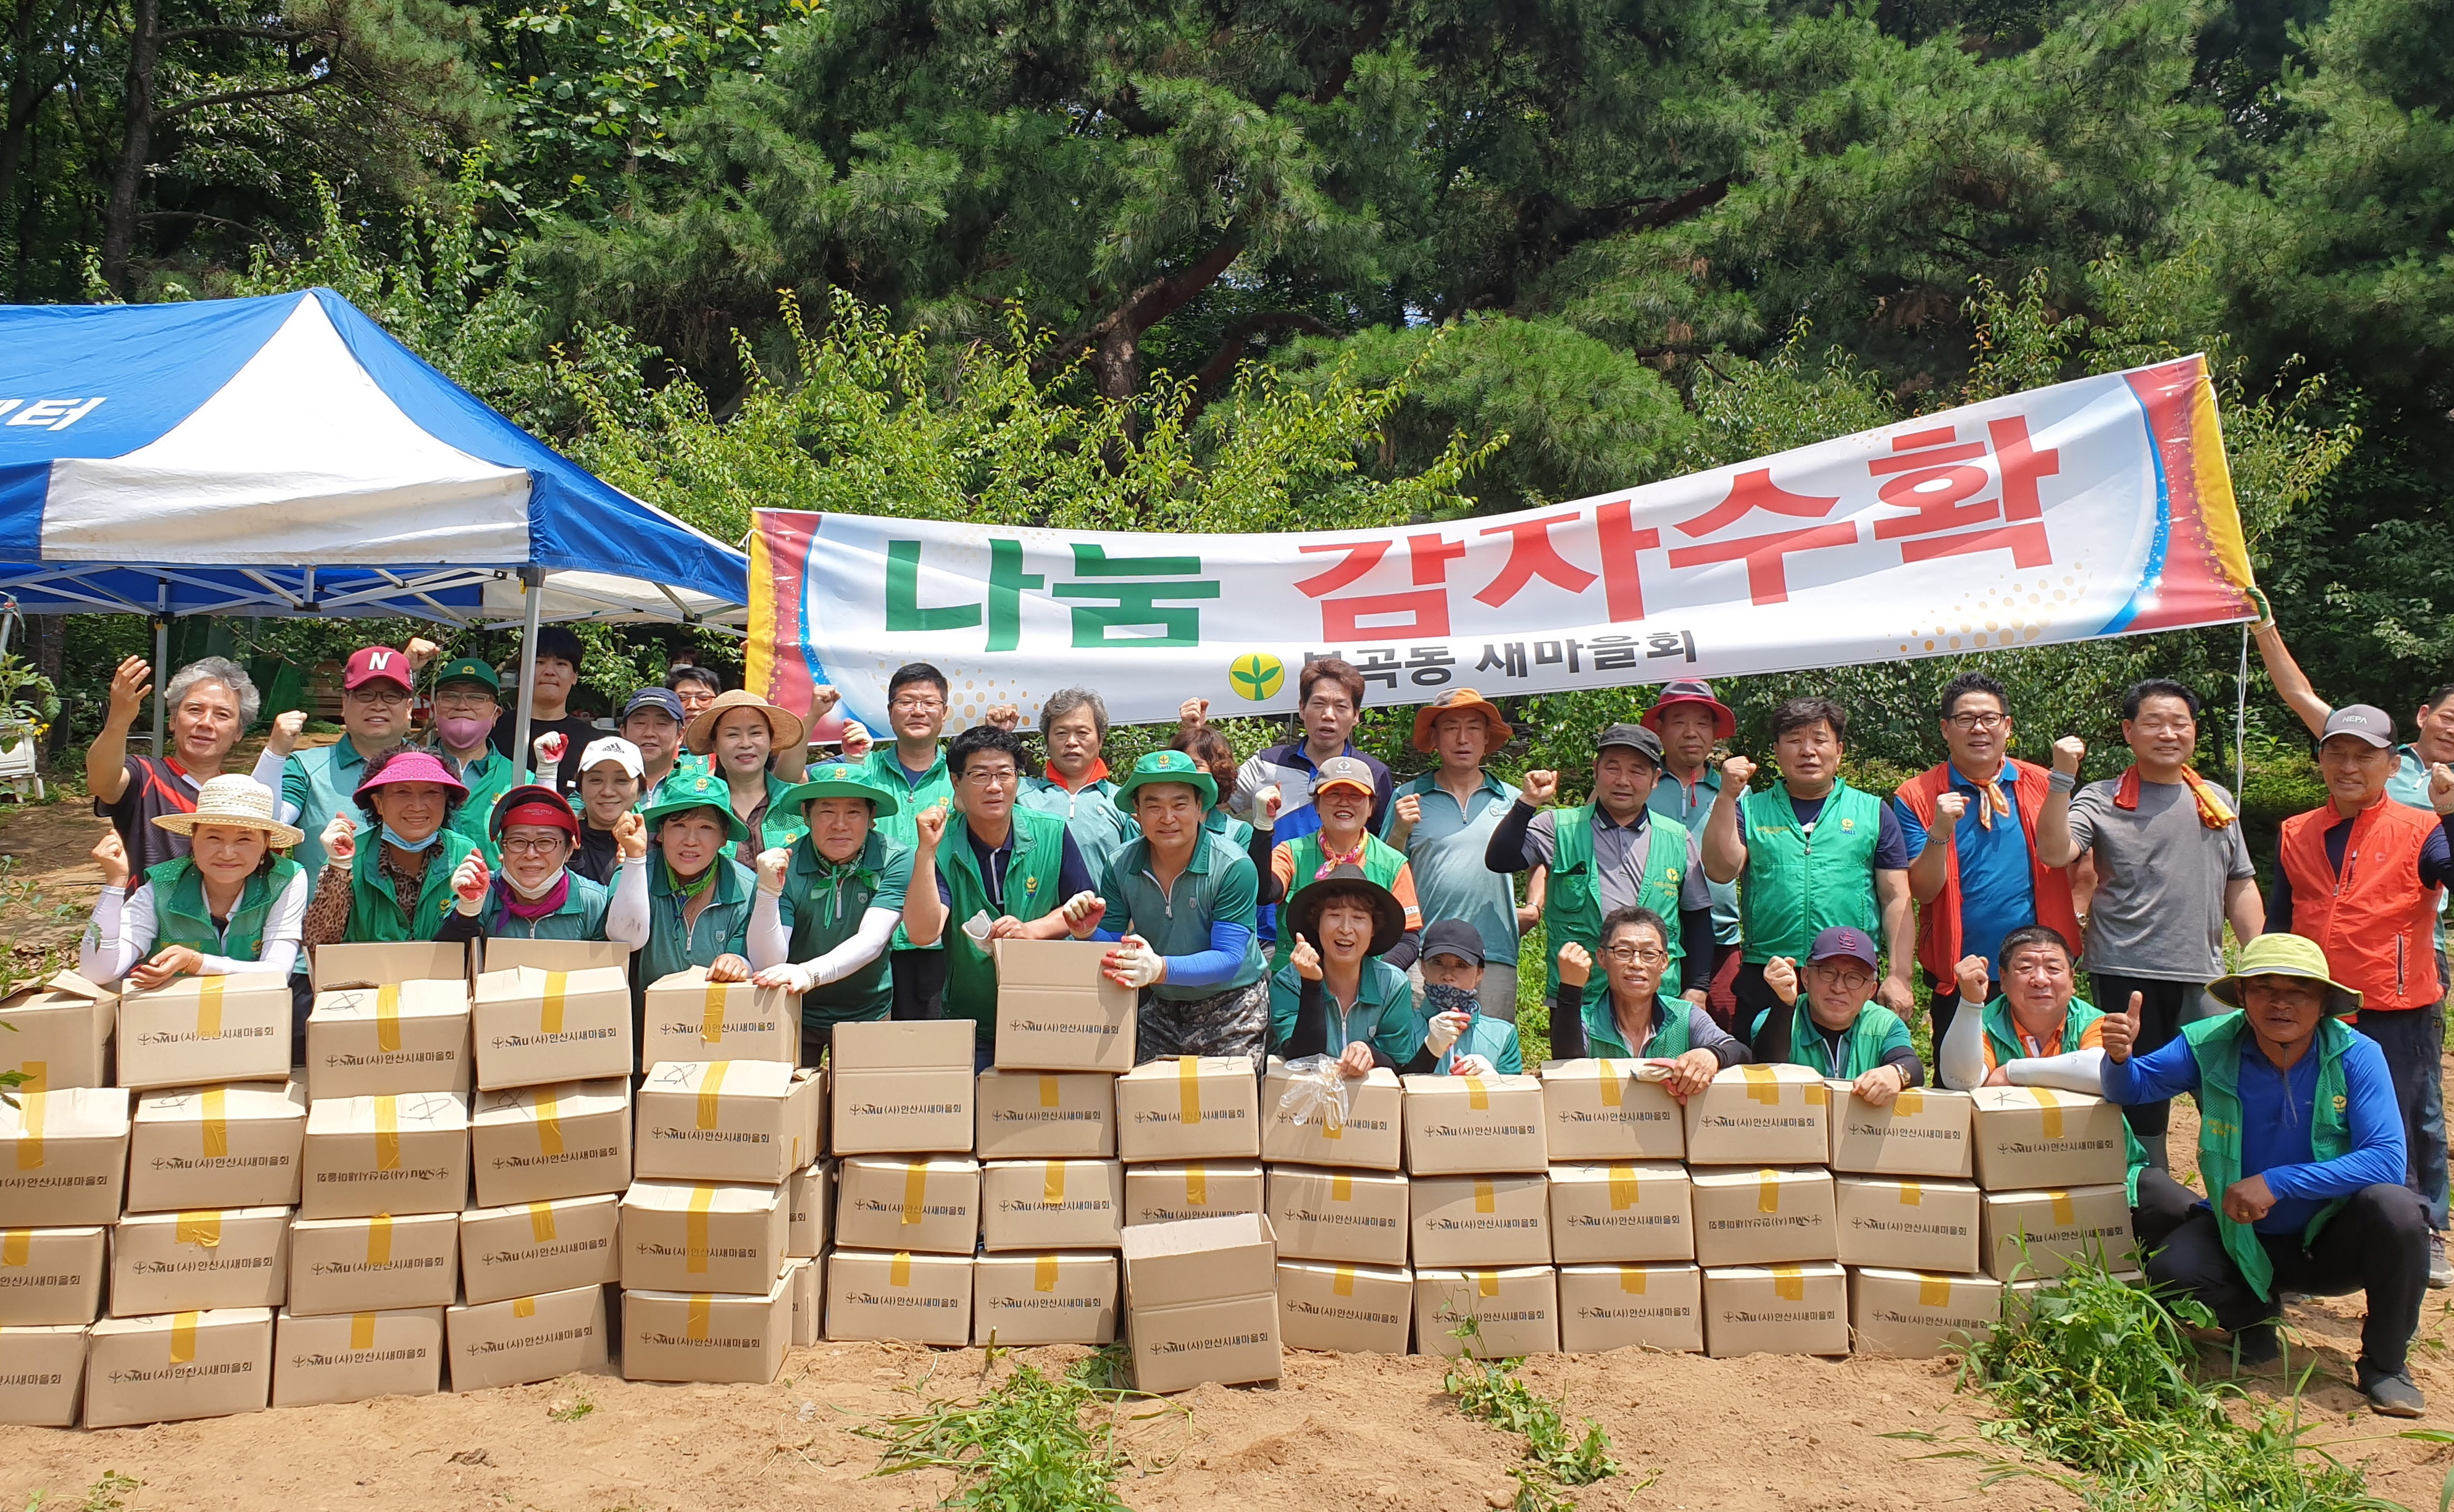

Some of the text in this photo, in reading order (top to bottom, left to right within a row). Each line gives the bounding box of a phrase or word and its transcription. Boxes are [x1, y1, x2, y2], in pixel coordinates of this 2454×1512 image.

[0, 397, 107, 430] 터
[887, 415, 2059, 651] 나눔 감자수확
[369, 651, 393, 670] N
[1475, 630, 1696, 678] 새마을회
[2342, 716, 2368, 725] NEPA
[1043, 1022, 1119, 1034] (사)안산시새마을회
[531, 1028, 617, 1045] (사)안산시새마을회
[366, 1051, 454, 1065] (사)안산시새마을회
[885, 1104, 961, 1114] (사)안산시새마을회
[1025, 1110, 1100, 1121] (사)안산시새마을회
[1593, 1111, 1670, 1122] (사)안산시새마을회
[1736, 1117, 1814, 1127] (사)안산시새마을회
[688, 1130, 769, 1143] (사)안산시새마을회
[1459, 1125, 1535, 1137] (사)안산시새마을회
[1883, 1127, 1960, 1139] (사)안산시새마을회
[2034, 1140, 2113, 1152] (사)안산시새마을회
[195, 1156, 289, 1169] (사)안산시새마을회
[532, 1147, 617, 1166] (사)안산시새마을회
[5, 1176, 107, 1188] (사)안산시새마을회
[317, 1169, 407, 1182] (사)안산시새마을회
[1319, 1213, 1395, 1227] (사)안산시새마을회
[1461, 1218, 1537, 1229] (사)안산시새마을회
[1602, 1215, 1680, 1226] (사)안산시새마을회
[1709, 1218, 1787, 1229] (사)안산시새마을회
[1887, 1221, 1966, 1236] (사)안산시새마을회
[521, 1238, 606, 1261] (사)안산시새마을회
[177, 1256, 272, 1272] (사)안산시새마을회
[880, 1296, 958, 1308] (사)안산시새마을회
[1024, 1298, 1101, 1308] (사)안산시새마을회
[1321, 1306, 1398, 1324] (사)안산시새마을회
[1476, 1310, 1544, 1322] )안산시새마을회
[1613, 1307, 1690, 1318] (사)안산시새마을회
[1758, 1311, 1835, 1321] (사)안산시새마을회
[1908, 1315, 1987, 1329] (사)안산시새마을회
[507, 1326, 593, 1351] (사)안산시새마을회
[1187, 1332, 1267, 1351] (사)안산시새마을회
[335, 1348, 426, 1364] (사)안산시새마을회
[153, 1361, 252, 1380] (사)안산시새마을회
